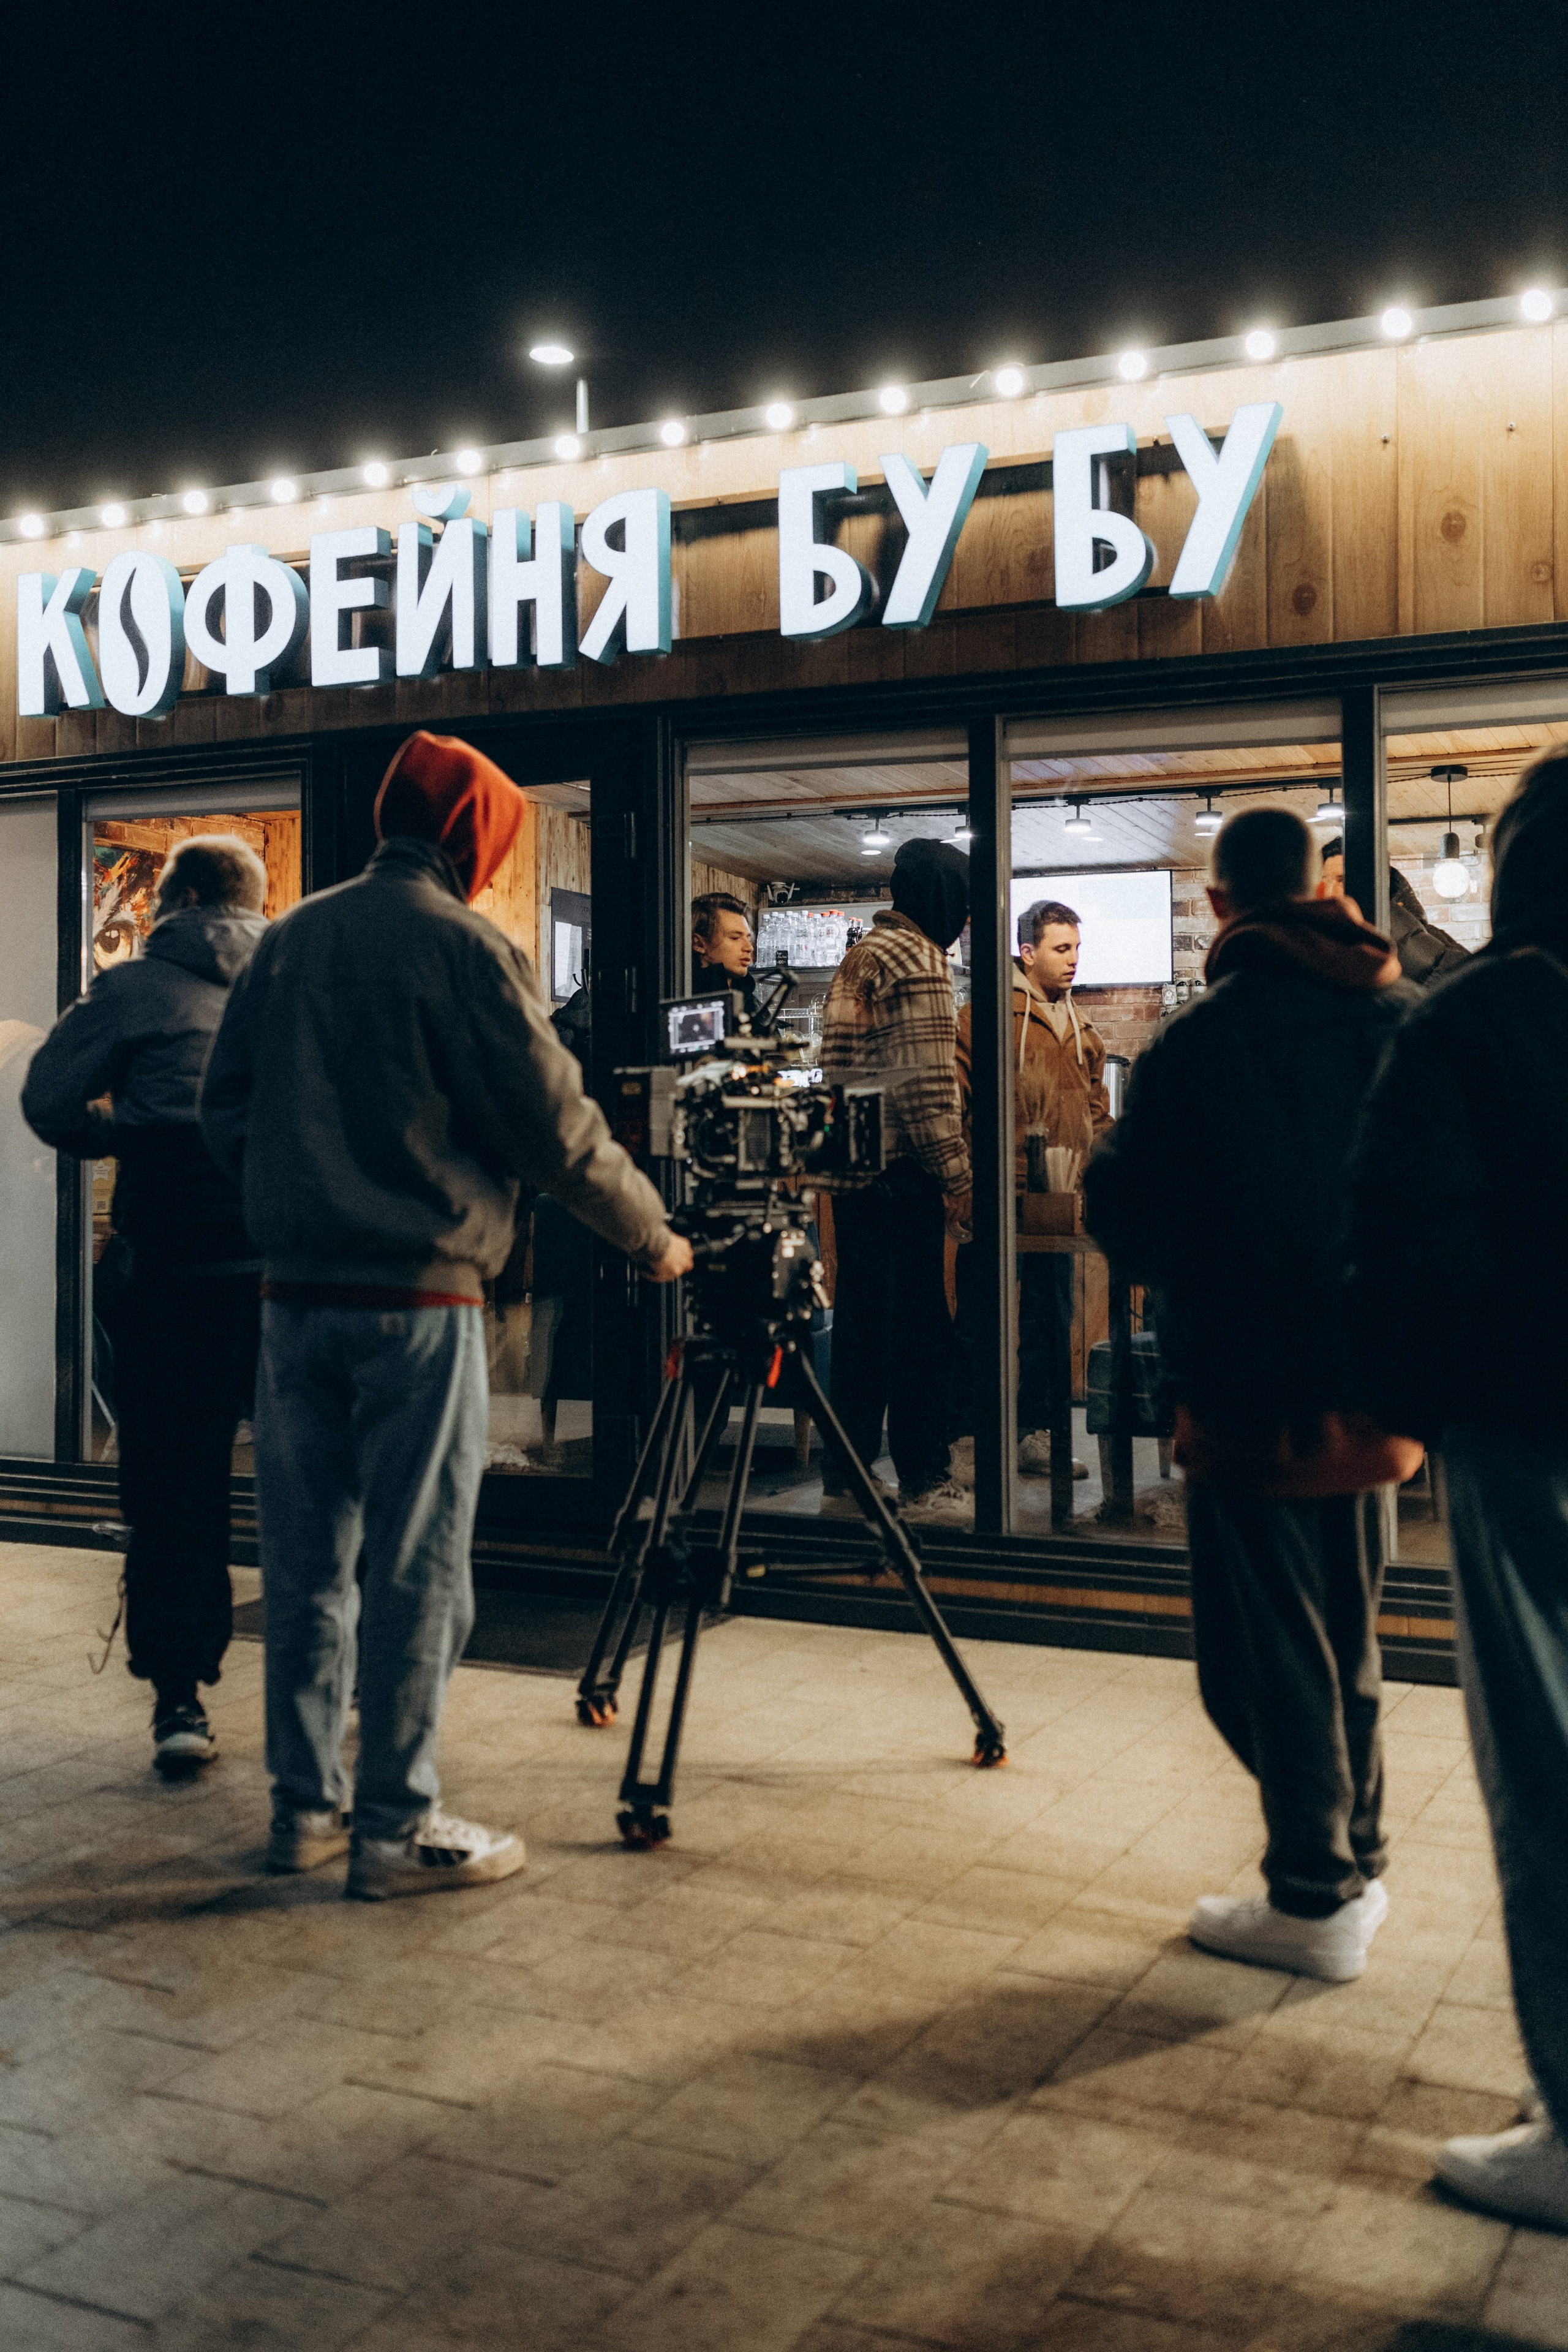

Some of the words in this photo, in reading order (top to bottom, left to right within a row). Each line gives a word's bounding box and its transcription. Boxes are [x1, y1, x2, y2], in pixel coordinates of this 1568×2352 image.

[17, 484, 671, 719] КОФЕЙНЯ
[778, 441, 989, 640] БУ
[1054, 401, 1283, 611] БУ
